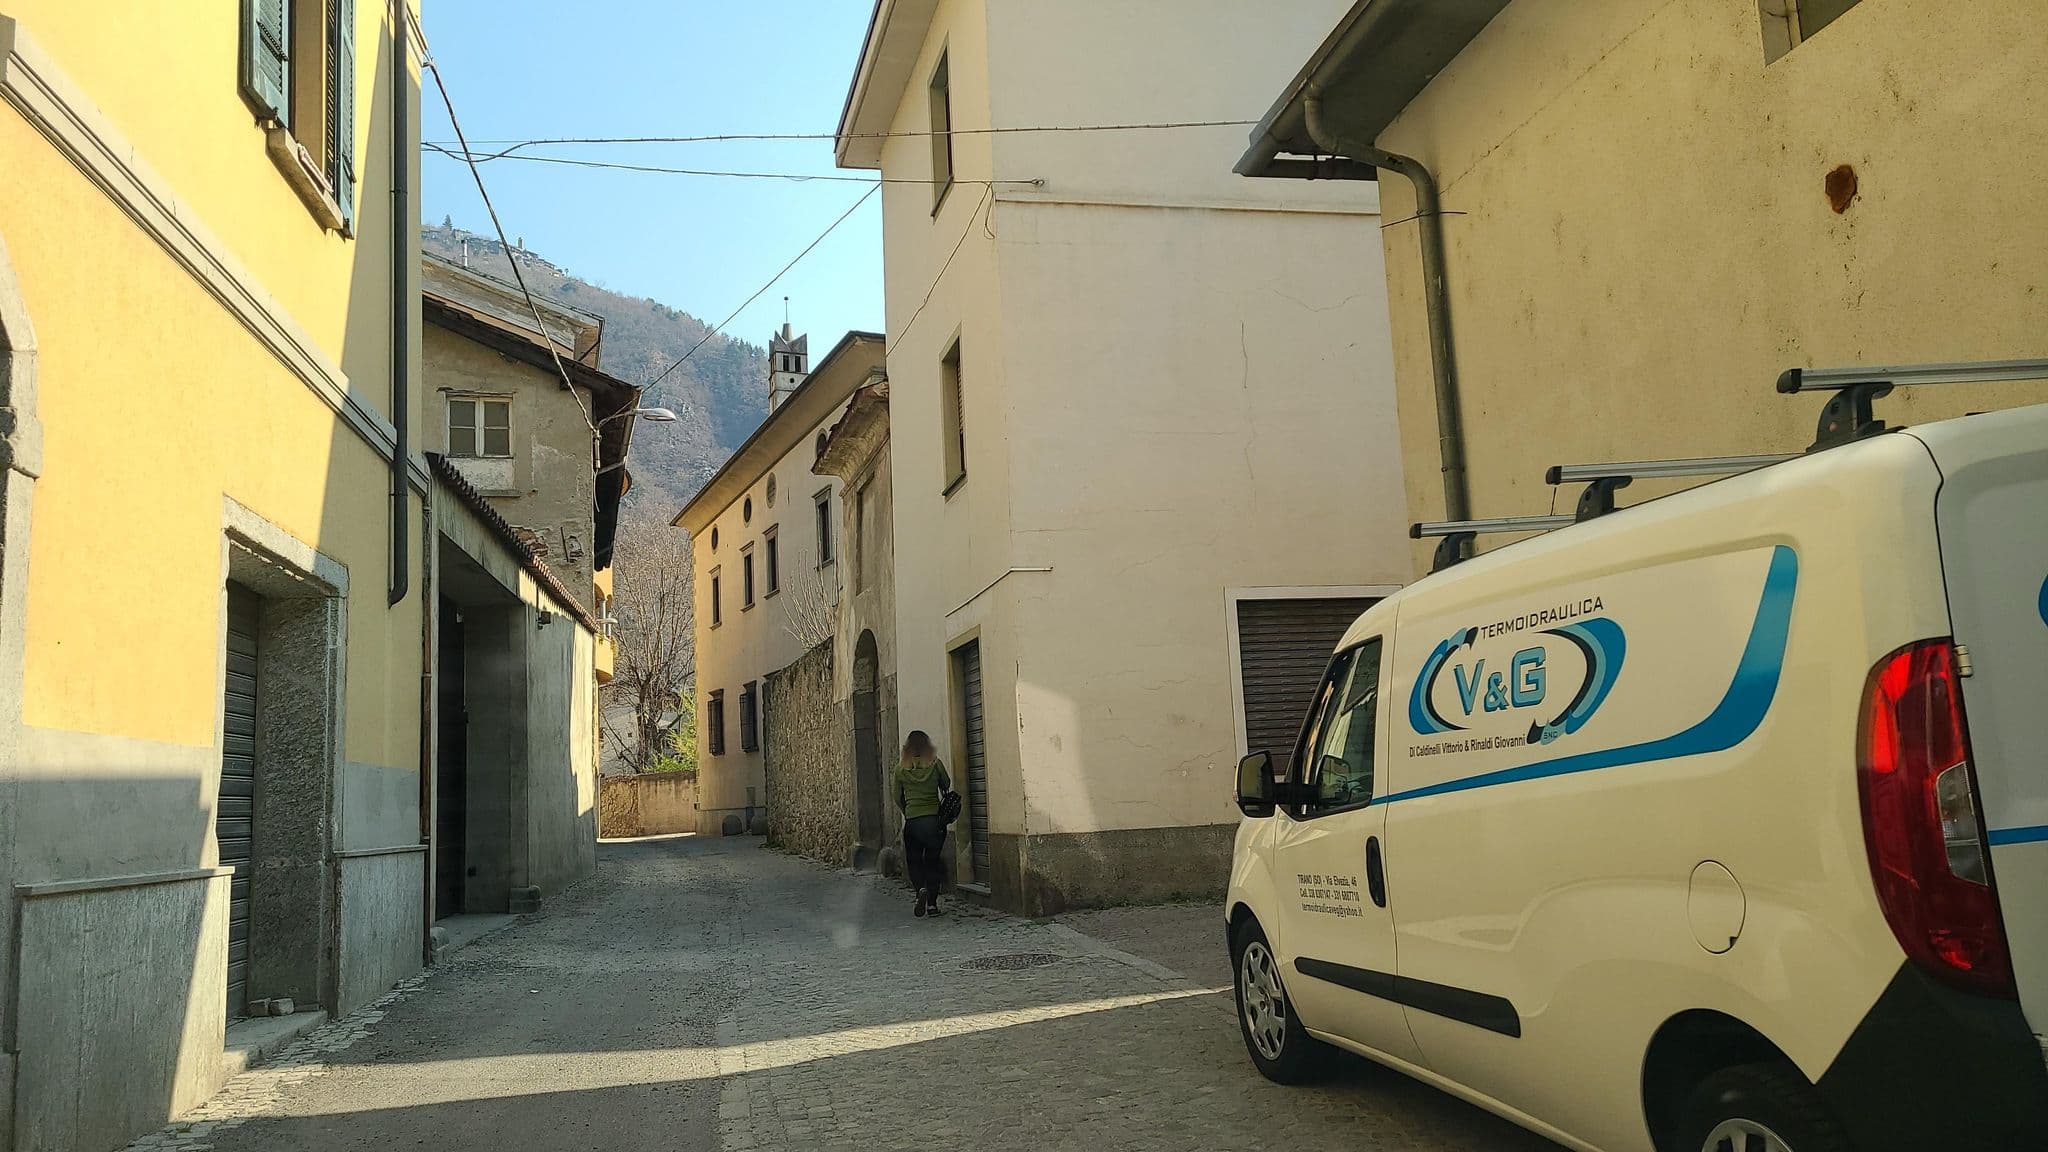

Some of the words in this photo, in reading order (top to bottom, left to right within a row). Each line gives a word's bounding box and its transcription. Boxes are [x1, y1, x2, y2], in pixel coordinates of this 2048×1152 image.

[1480, 596, 1604, 640] TERMOIDRAULICA
[1453, 646, 1546, 716] V&G
[1409, 746, 1416, 758] Di
[1442, 741, 1464, 754] Vittorio
[1464, 740, 1470, 752] &
[1470, 738, 1493, 751] Rinaldi
[1494, 733, 1526, 749] Giovanni
[1325, 875, 1333, 886] Via
